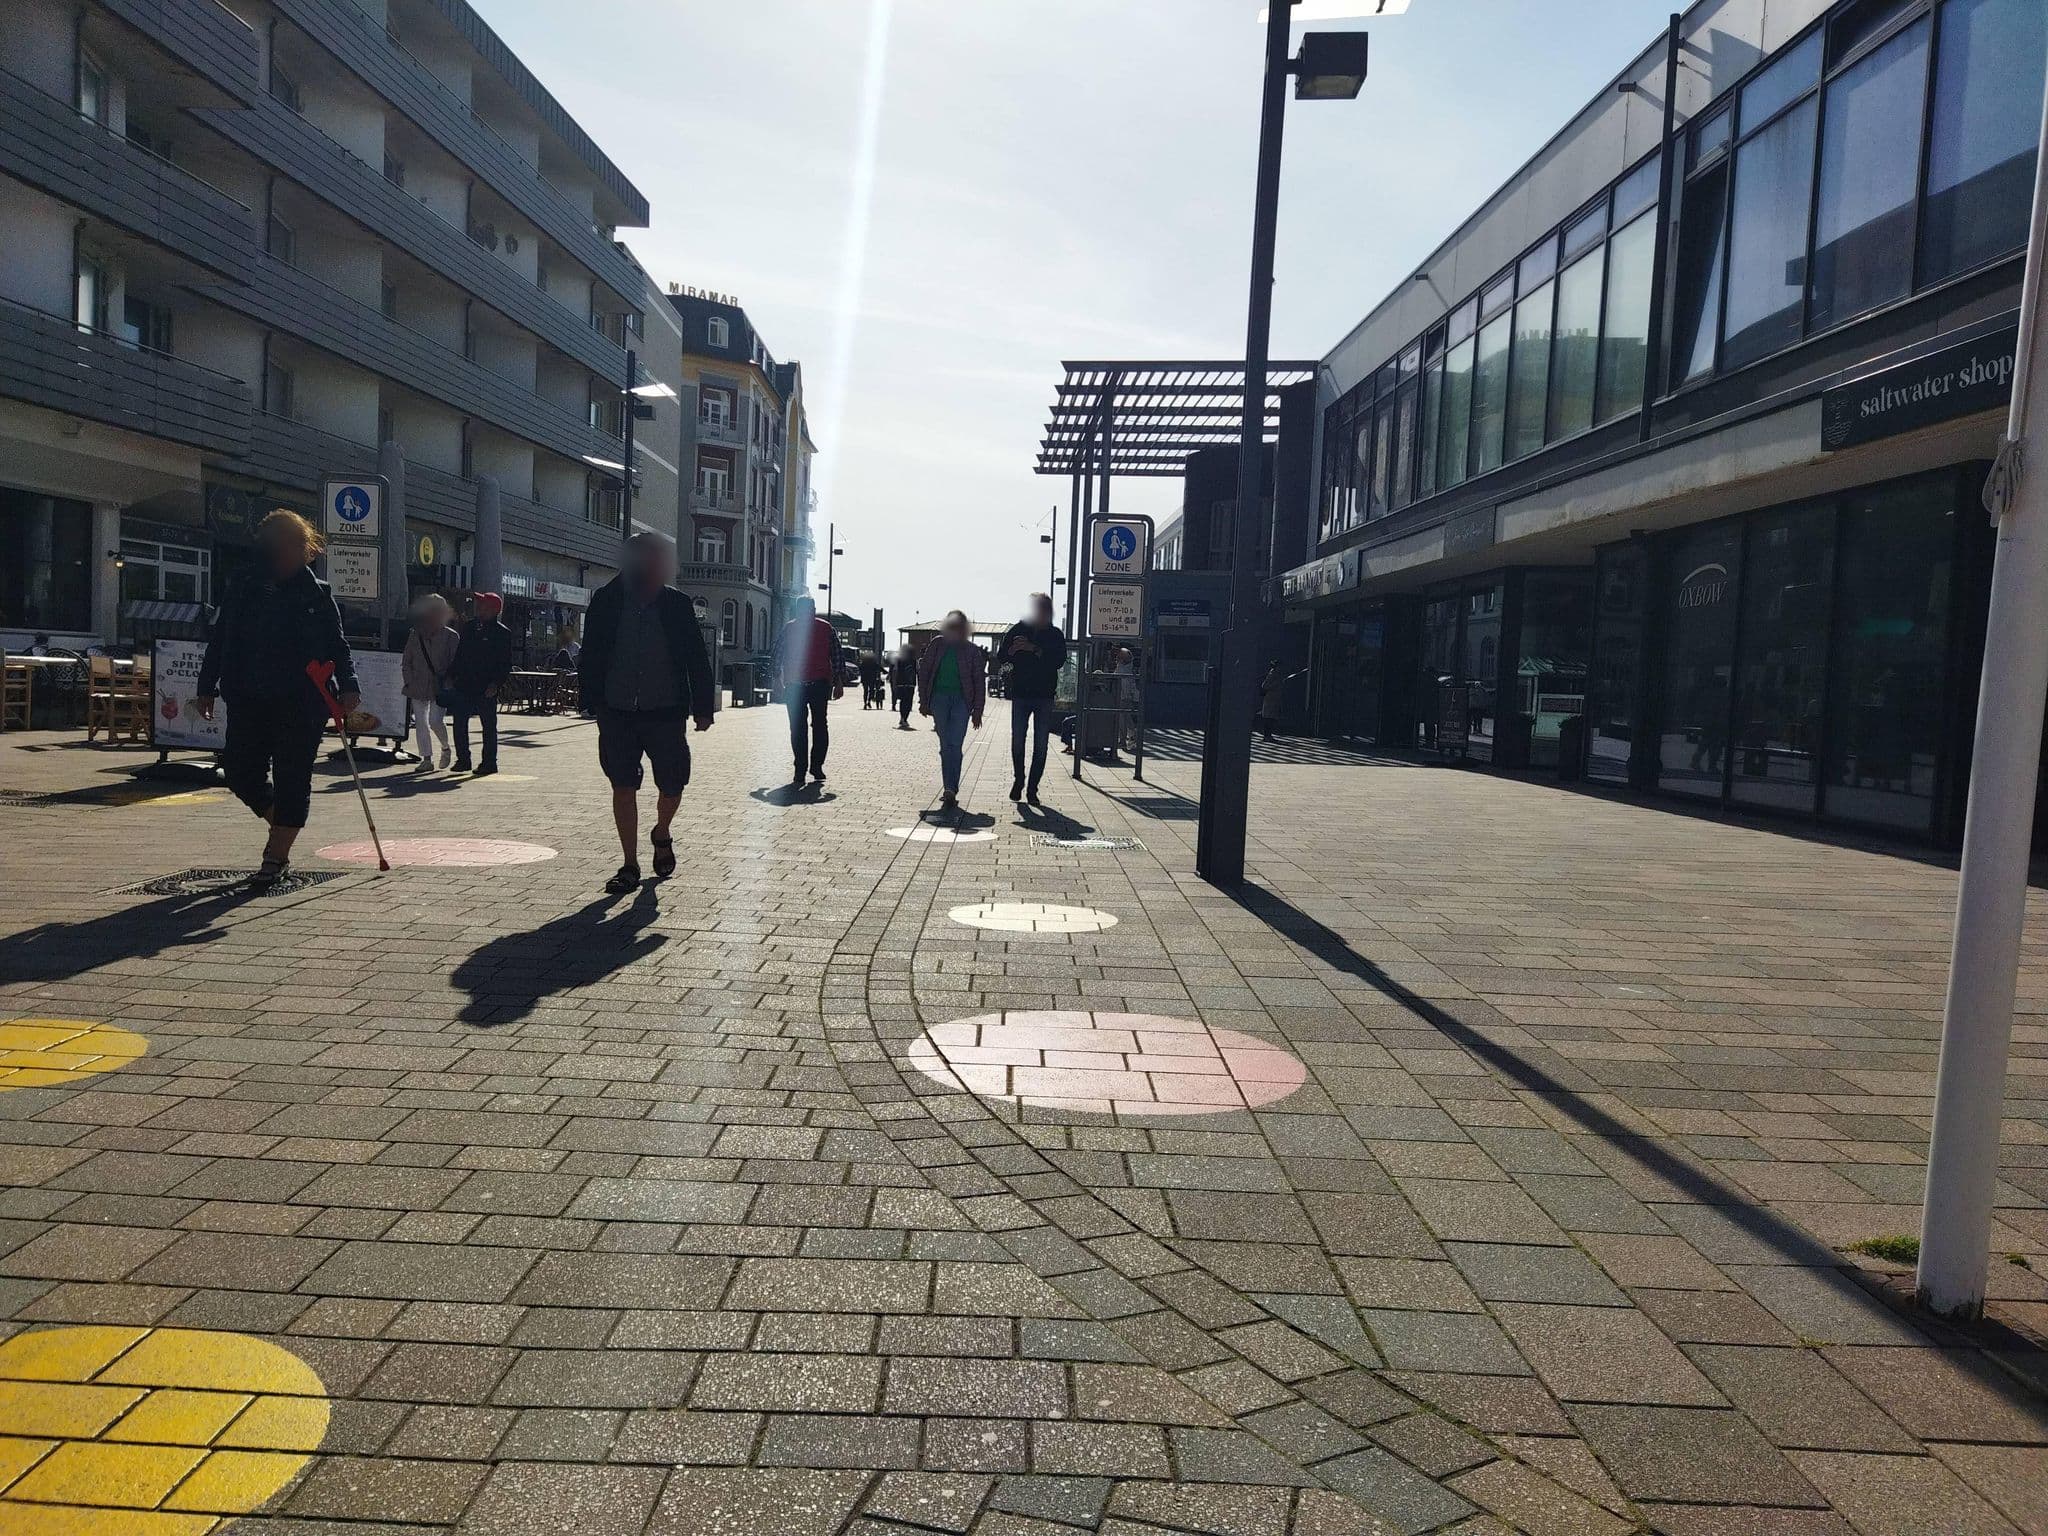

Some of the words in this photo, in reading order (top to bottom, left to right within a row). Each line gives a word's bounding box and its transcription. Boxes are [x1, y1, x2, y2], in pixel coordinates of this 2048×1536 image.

[669, 281, 739, 307] MIRAMAR
[1860, 371, 1954, 418] saltwater
[1958, 354, 2013, 390] shop
[339, 522, 366, 533] ZONE
[333, 548, 372, 558] Lieferverkehr
[350, 567, 366, 576] 7-10
[1105, 562, 1131, 572] ZONE
[1098, 588, 1135, 597] Lieferverkehr
[1679, 581, 1727, 608] OXBOW
[1110, 597, 1123, 605] frei
[1114, 606, 1129, 614] 7-10
[1109, 615, 1122, 623] und
[182, 652, 205, 661] IT'S
[172, 660, 204, 669] SPRIT
[166, 668, 200, 678] O'CLO
